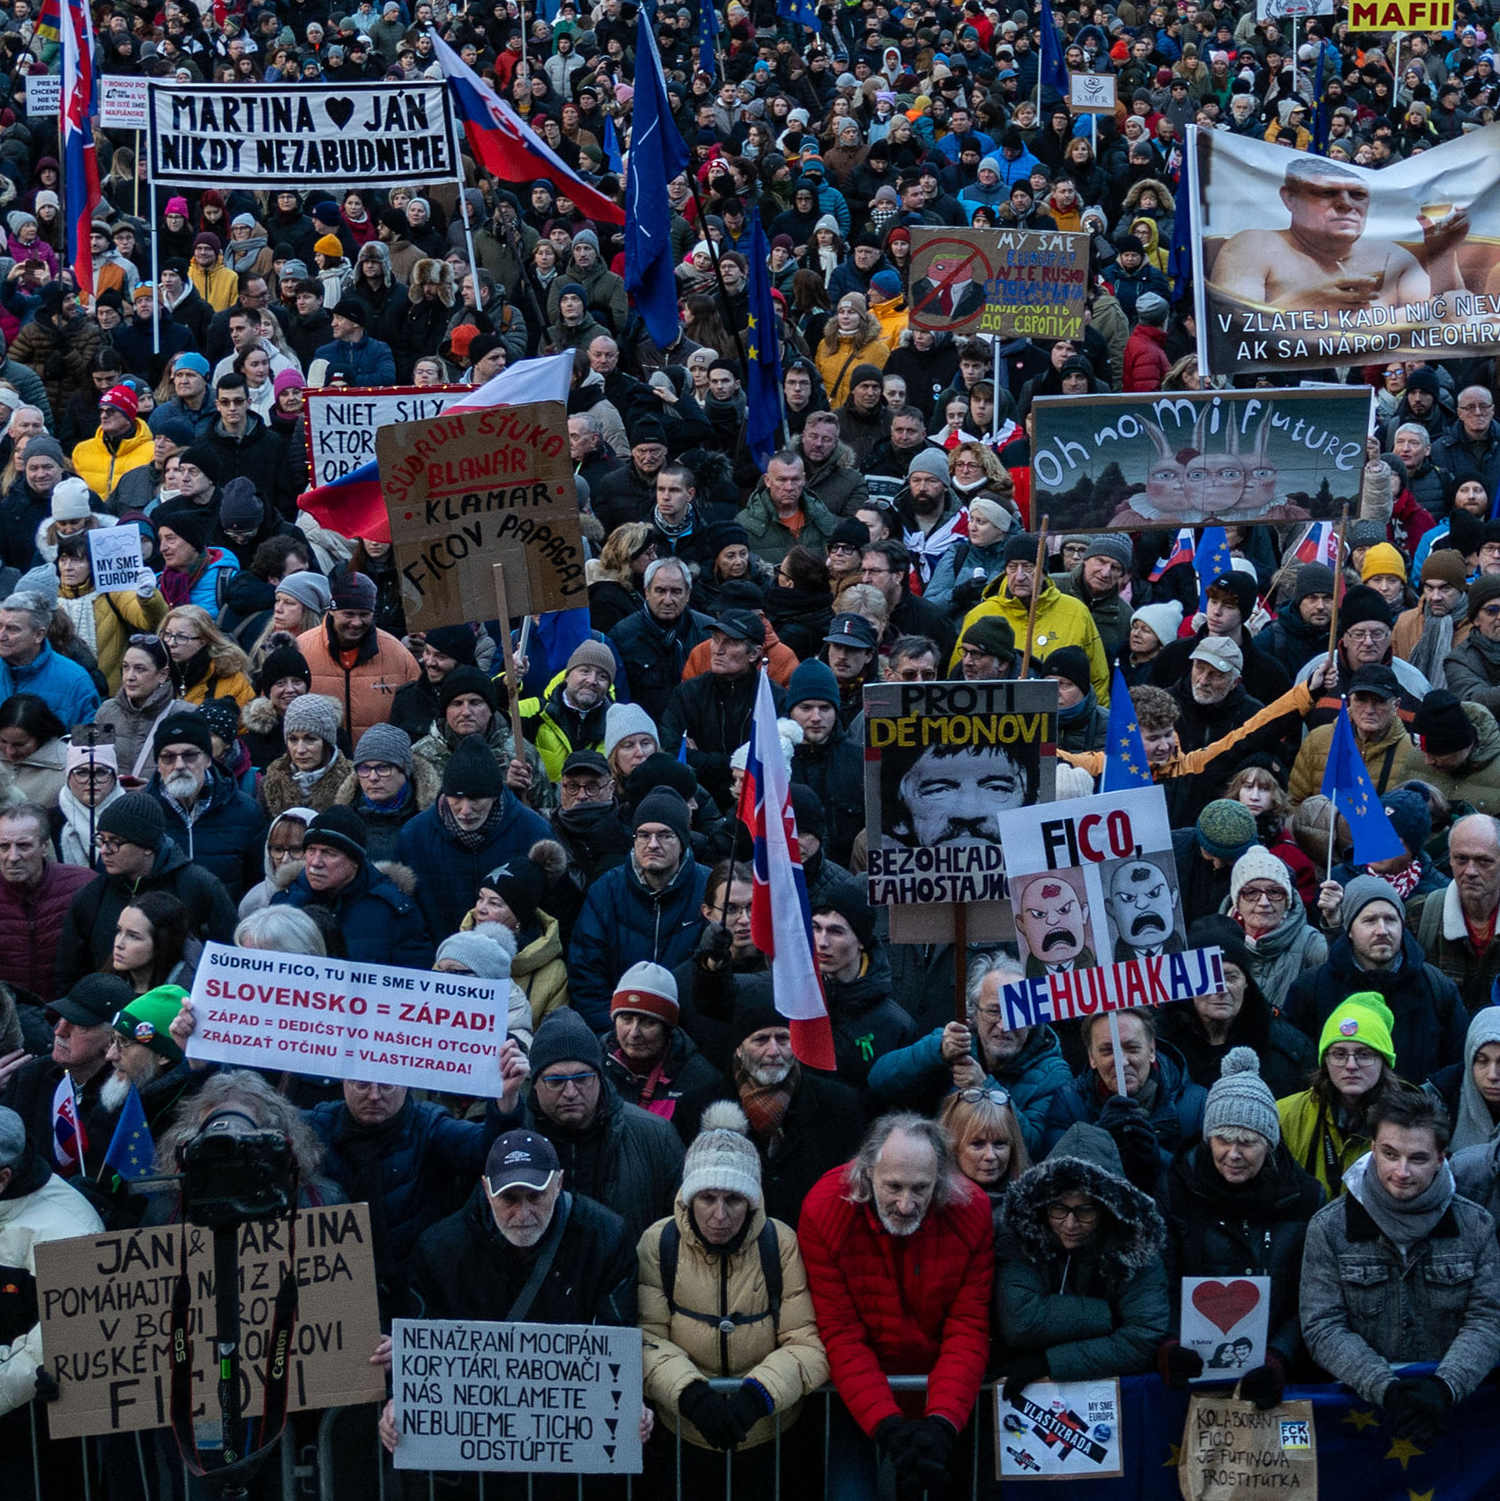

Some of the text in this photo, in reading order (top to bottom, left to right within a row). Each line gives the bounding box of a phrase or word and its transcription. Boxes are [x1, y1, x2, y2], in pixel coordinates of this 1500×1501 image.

[1353, 3, 1450, 27] MAFII
[172, 89, 430, 133] MARTINA JÁN
[161, 134, 447, 174] NIKDY NEZABUDNEME
[997, 232, 1075, 252] MY SME
[996, 265, 1085, 284] NIE RUSKO
[980, 313, 1082, 338] ДО ЄВРОПИ!
[1218, 313, 1233, 333] V
[1242, 310, 1330, 333] ZLATEJ
[1339, 307, 1397, 329] KADI
[1405, 293, 1447, 323] NIČ
[1237, 339, 1268, 361] AK
[1278, 338, 1309, 359] SA
[1318, 330, 1401, 356] NÁROD
[326, 403, 377, 426] NIET
[319, 429, 375, 455] KTOR
[385, 416, 466, 502] SÚDRUH
[427, 442, 528, 489] BLANÁR
[97, 555, 139, 571] MY SME
[402, 521, 484, 596] FICOV
[99, 570, 141, 587] EURÓPA
[901, 684, 1015, 715] PROTI
[870, 710, 1049, 748] DÉMONOVI
[1040, 809, 1143, 870] FICO,
[210, 952, 495, 1000] SÚDRUH FICO, TU NIE SME V RUSKU!
[1002, 947, 1225, 1031] NEHULIAKAJ!
[206, 978, 496, 1033] SLOVENSKO ZÁPAD!
[208, 1009, 260, 1027] ZÁPAD
[374, 1031, 433, 1049] NAŠICH
[437, 1039, 497, 1057] OTCOV!
[202, 1029, 472, 1075] ZRÁDZAŤ OTČINU VLASTIZRADA!
[95, 1209, 364, 1275] JÁN & ARTINA
[43, 1276, 184, 1321] POMÁHAJT
[251, 1263, 269, 1290] Z
[100, 1317, 121, 1342] V
[403, 1325, 612, 1357] NENAŽRANÍ MOCIPÁNI,
[174, 1327, 186, 1364] EOS
[271, 1328, 290, 1381] Canon
[402, 1352, 600, 1382] KORYTÁRI, RABOVAČI
[403, 1376, 587, 1410] NÁS NEOKLAMETE
[1088, 1401, 1114, 1411] MY SME
[403, 1409, 593, 1440] NEBUDEME TICHO
[1023, 1401, 1093, 1455] VLASTIZRADA
[1197, 1407, 1289, 1430] KOLABORANT
[1281, 1425, 1308, 1435] FCK
[461, 1436, 574, 1462] ODSTÚPTE
[1199, 1430, 1235, 1447] FICO
[1282, 1435, 1309, 1445] PTN
[1197, 1449, 1290, 1468] JE PUTINOVA
[1201, 1468, 1300, 1488] PROSTITÚTKA
